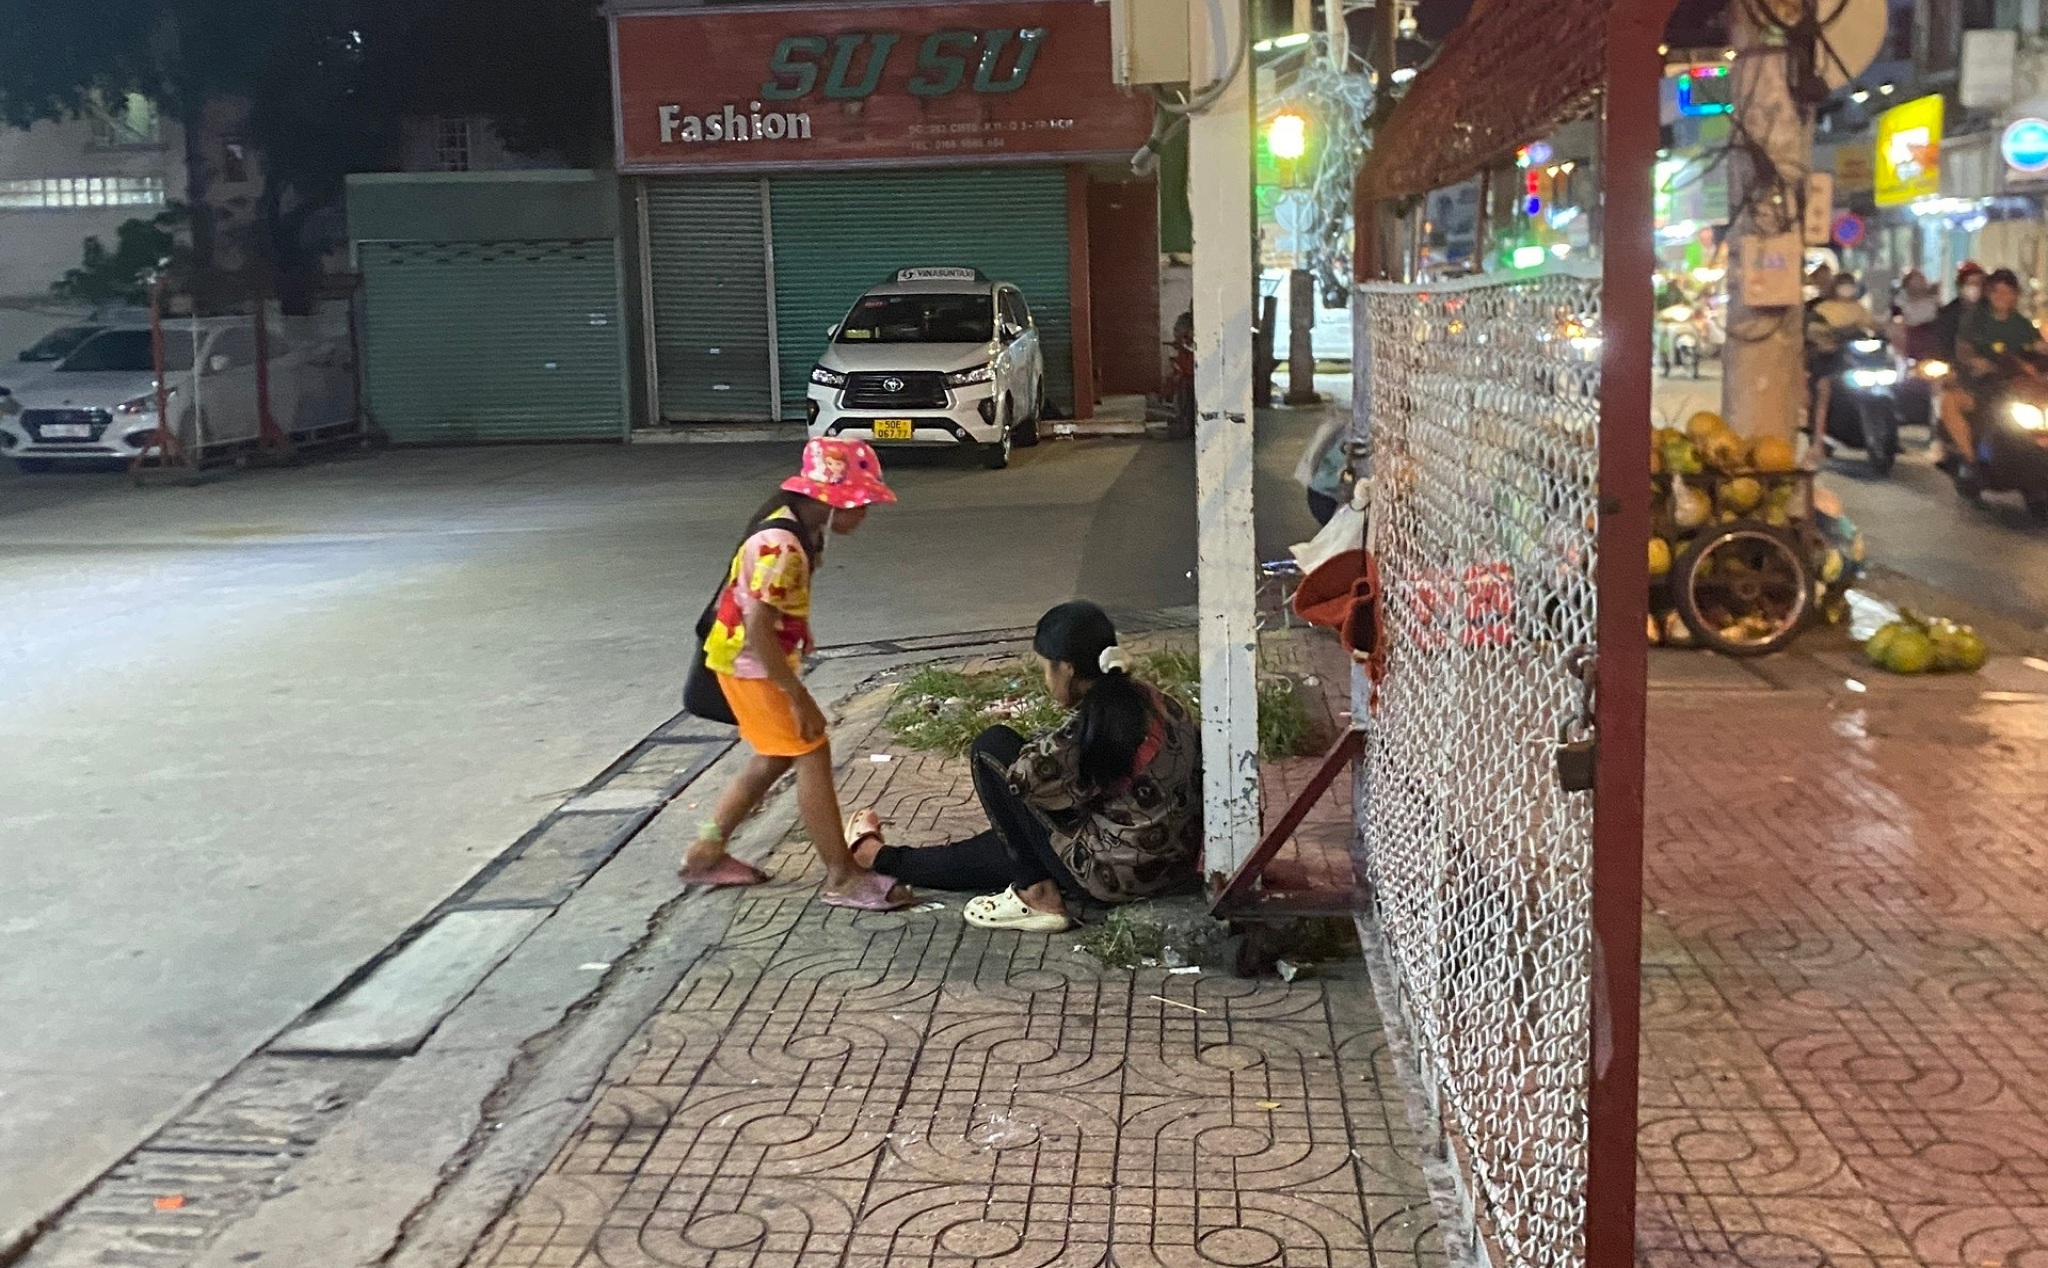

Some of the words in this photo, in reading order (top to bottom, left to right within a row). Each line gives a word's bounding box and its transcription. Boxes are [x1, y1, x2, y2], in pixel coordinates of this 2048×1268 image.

[761, 34, 898, 99] SU
[907, 27, 1047, 94] SU
[658, 101, 812, 143] Fashion
